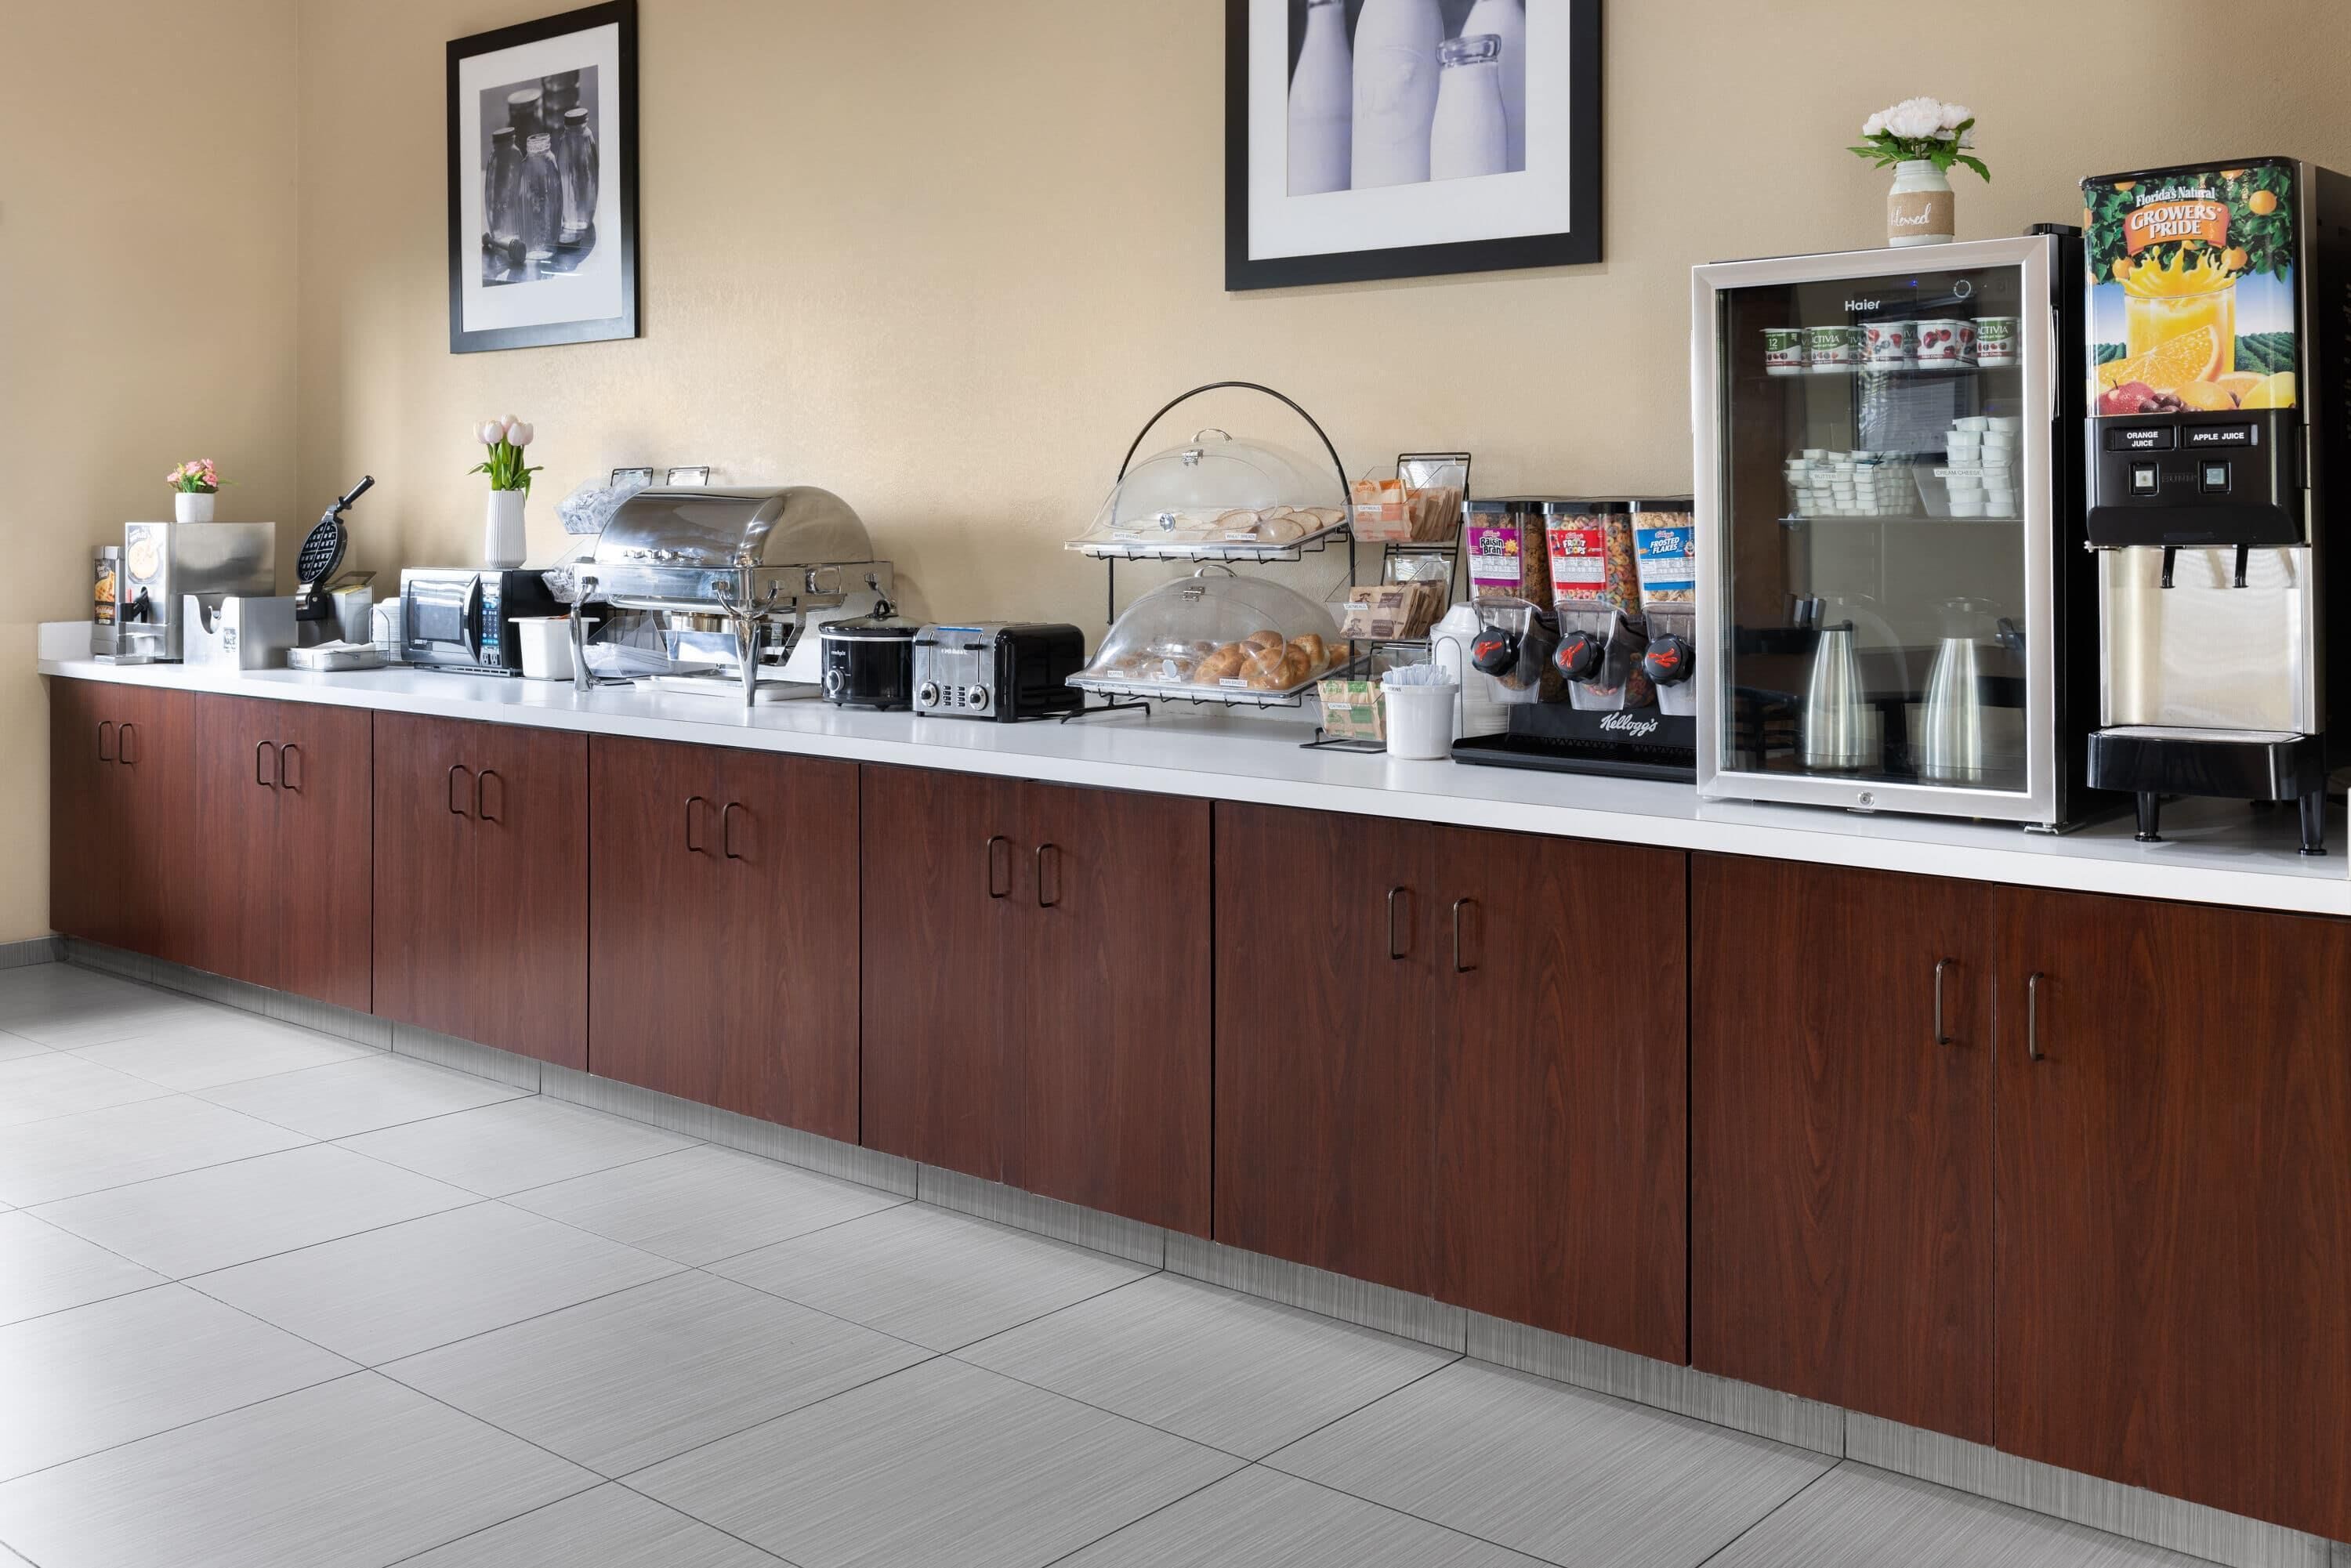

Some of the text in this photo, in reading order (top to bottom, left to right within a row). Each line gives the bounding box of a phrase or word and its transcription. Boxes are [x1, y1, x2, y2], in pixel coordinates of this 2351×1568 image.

[2135, 186, 2215, 207] Florida's Natural
[2150, 220, 2202, 239] PRIDE
[1845, 299, 1881, 311] Haier
[1769, 338, 1778, 347] 12
[2221, 432, 2245, 440] JUICE
[1480, 537, 1504, 548] Raisin
[1650, 537, 1680, 549] FROSTED
[1483, 545, 1502, 555] Bran
[1652, 544, 1679, 555] FLAKES
[1599, 712, 1658, 737] Kellogg's
